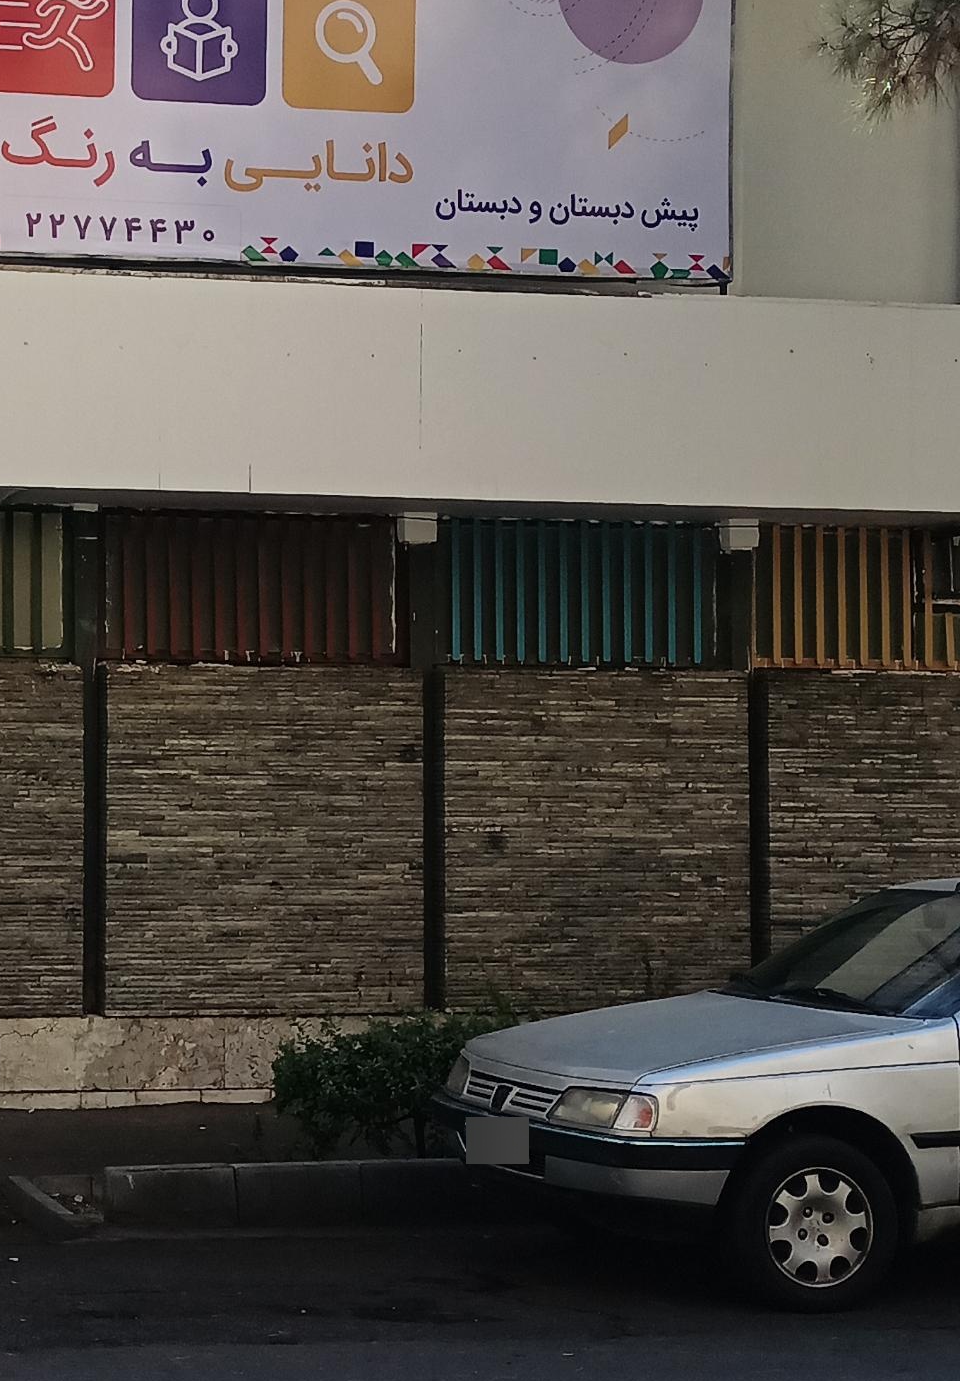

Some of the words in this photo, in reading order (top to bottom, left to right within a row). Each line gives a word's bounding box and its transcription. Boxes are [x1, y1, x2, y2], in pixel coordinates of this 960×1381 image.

[0, 115, 117, 188] رنگ
[129, 139, 214, 189] به
[223, 139, 414, 194] دانایی
[435, 188, 523, 221] دبستان
[528, 200, 543, 225] و
[549, 193, 635, 226] دبستان
[640, 197, 699, 232] پیش
[25, 212, 215, 245] ۲۲۷۷۴۴۳۰
